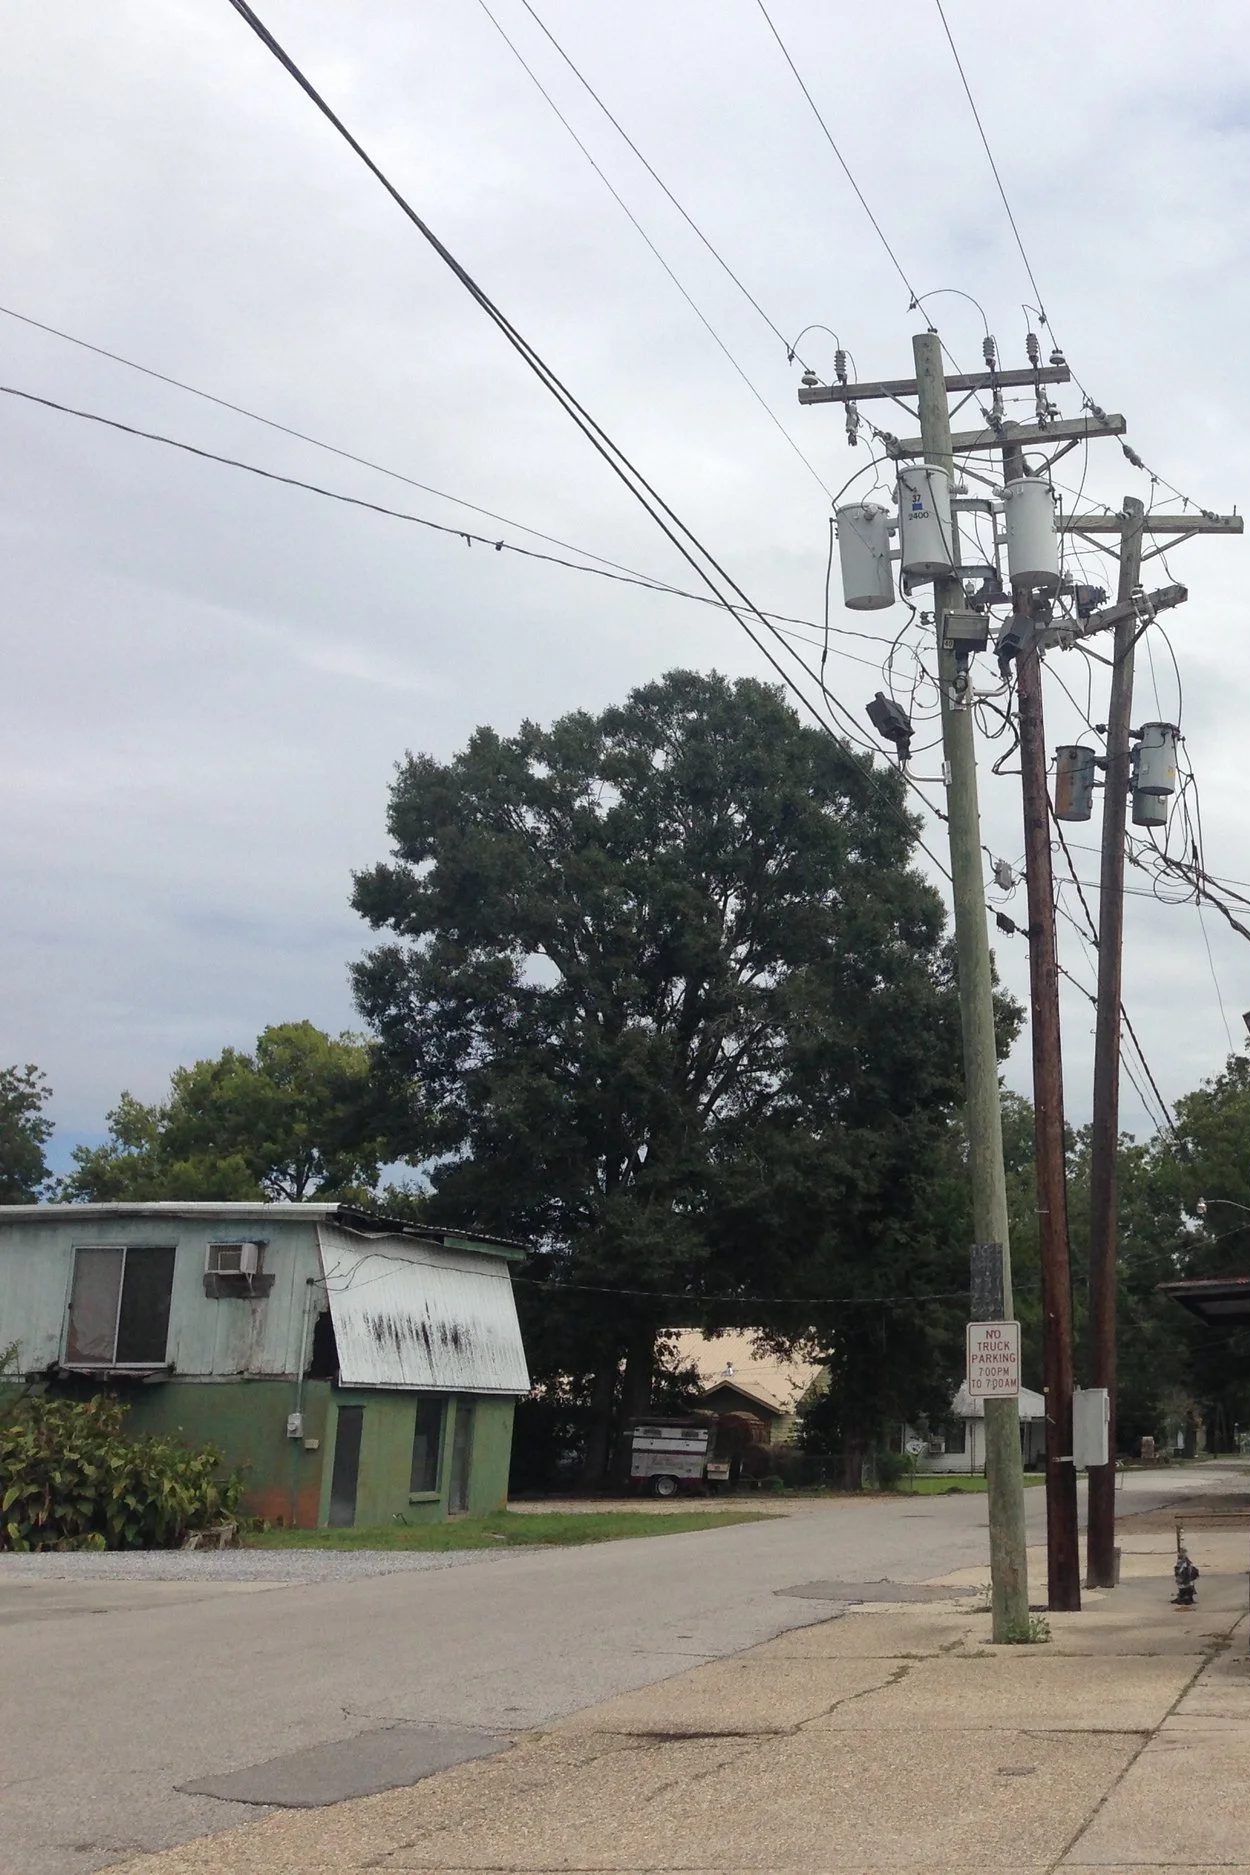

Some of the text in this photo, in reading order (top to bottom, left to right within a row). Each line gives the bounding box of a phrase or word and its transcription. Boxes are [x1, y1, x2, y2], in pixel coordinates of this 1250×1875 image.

[912, 494, 921, 503] 37
[908, 511, 929, 520] 2400
[986, 1330, 1001, 1339] NO
[977, 1341, 1010, 1351] TRUCK
[971, 1353, 1016, 1363] PARKING
[971, 1379, 982, 1388] TO
